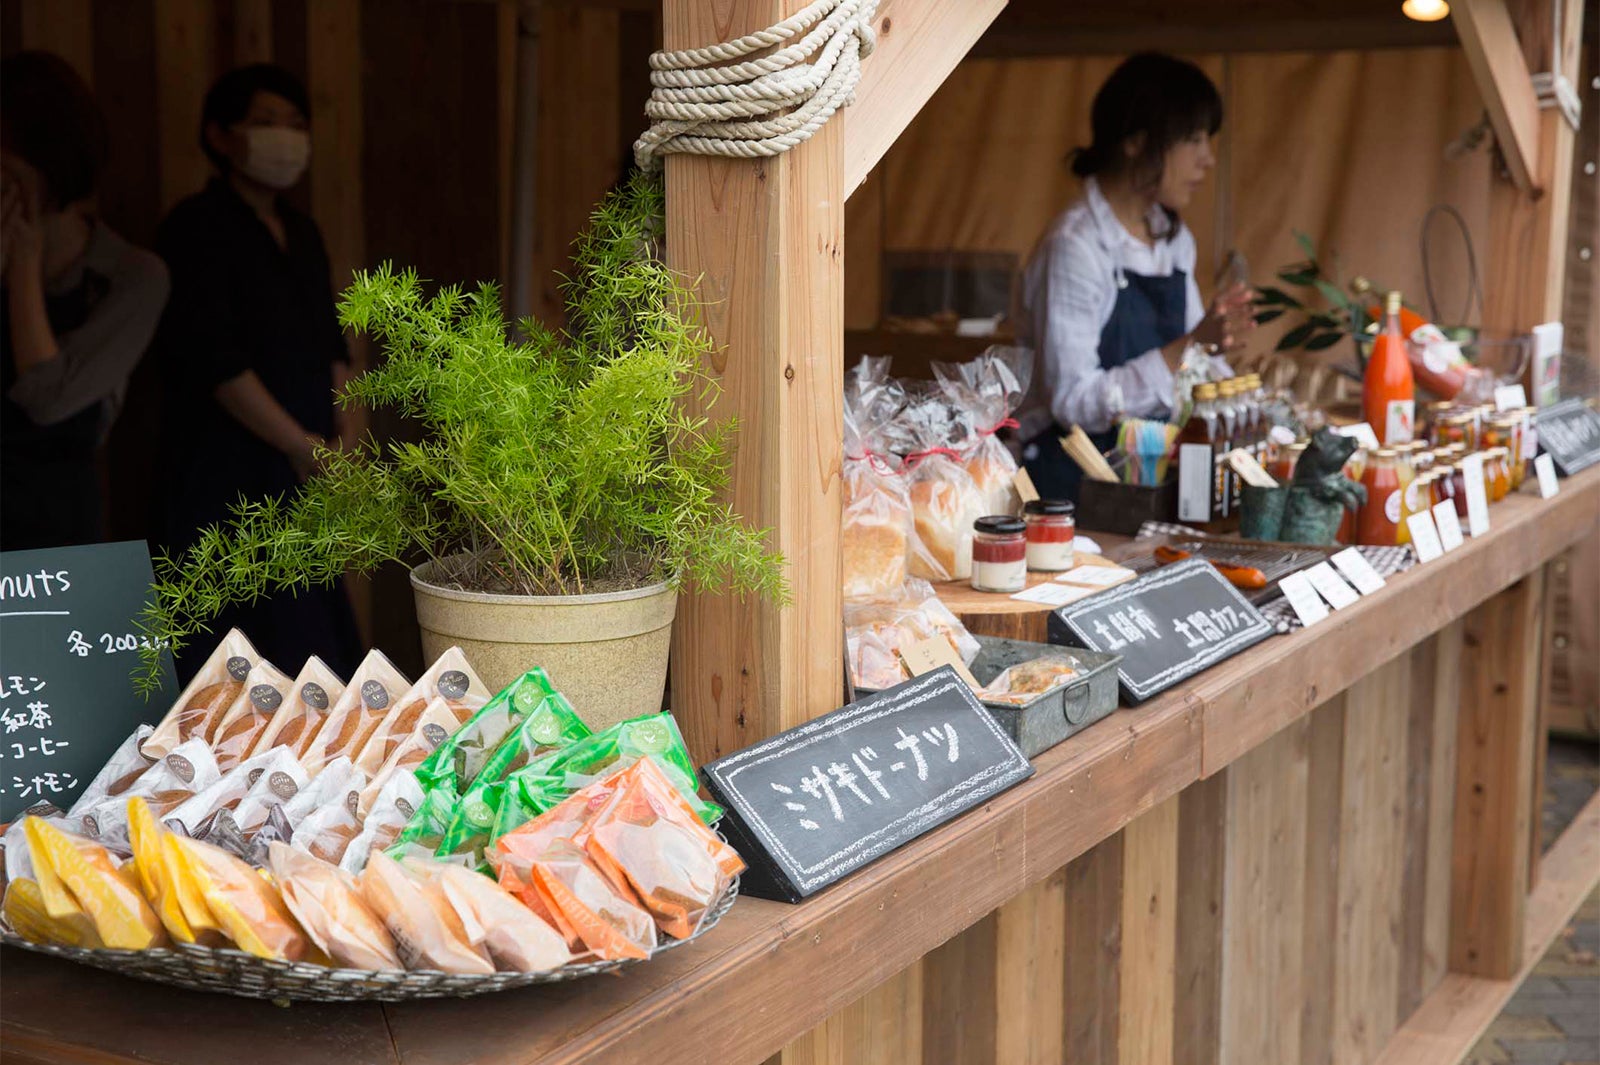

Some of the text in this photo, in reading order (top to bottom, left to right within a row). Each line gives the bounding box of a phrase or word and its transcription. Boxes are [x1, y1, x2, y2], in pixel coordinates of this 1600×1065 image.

[1172, 610, 1255, 653] 土間カフェ
[0, 701, 52, 734] 紅茶
[770, 722, 960, 831] ミサキドーナツ
